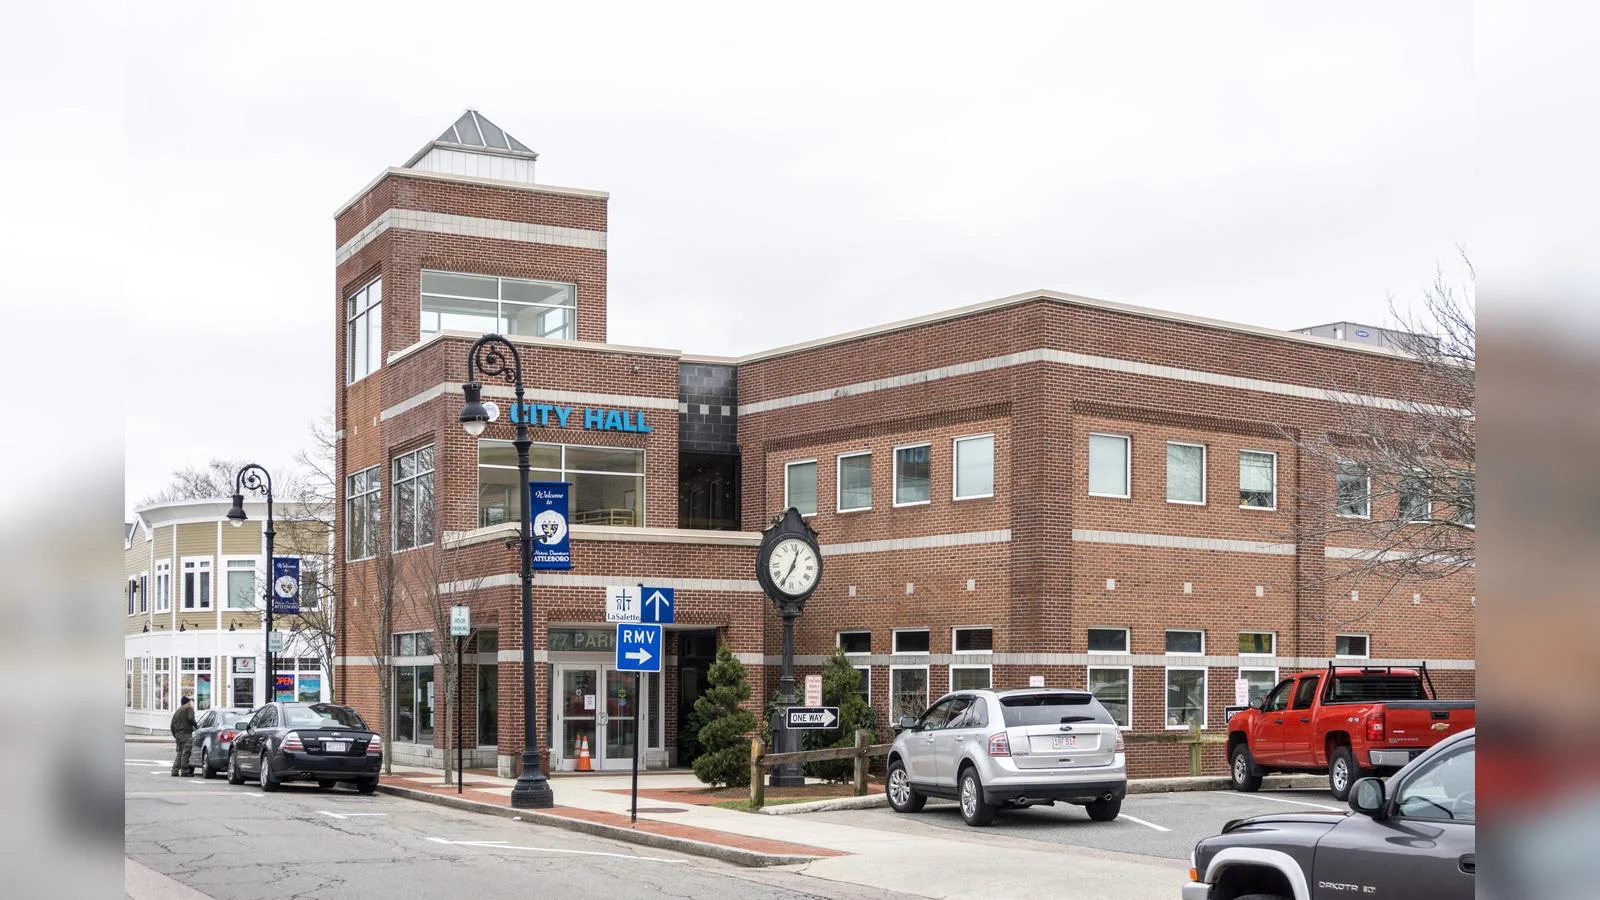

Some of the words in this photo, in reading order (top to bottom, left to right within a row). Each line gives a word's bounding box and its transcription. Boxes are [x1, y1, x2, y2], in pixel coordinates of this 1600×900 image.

[510, 402, 572, 428] CITY
[584, 407, 652, 433] HALL
[535, 490, 564, 499] Welcome
[607, 613, 640, 621] LaSalette
[550, 633, 569, 648] 77
[623, 630, 655, 644] RMV
[276, 677, 293, 685] OPEN
[792, 714, 807, 722] ONE
[809, 714, 823, 722] WAY
